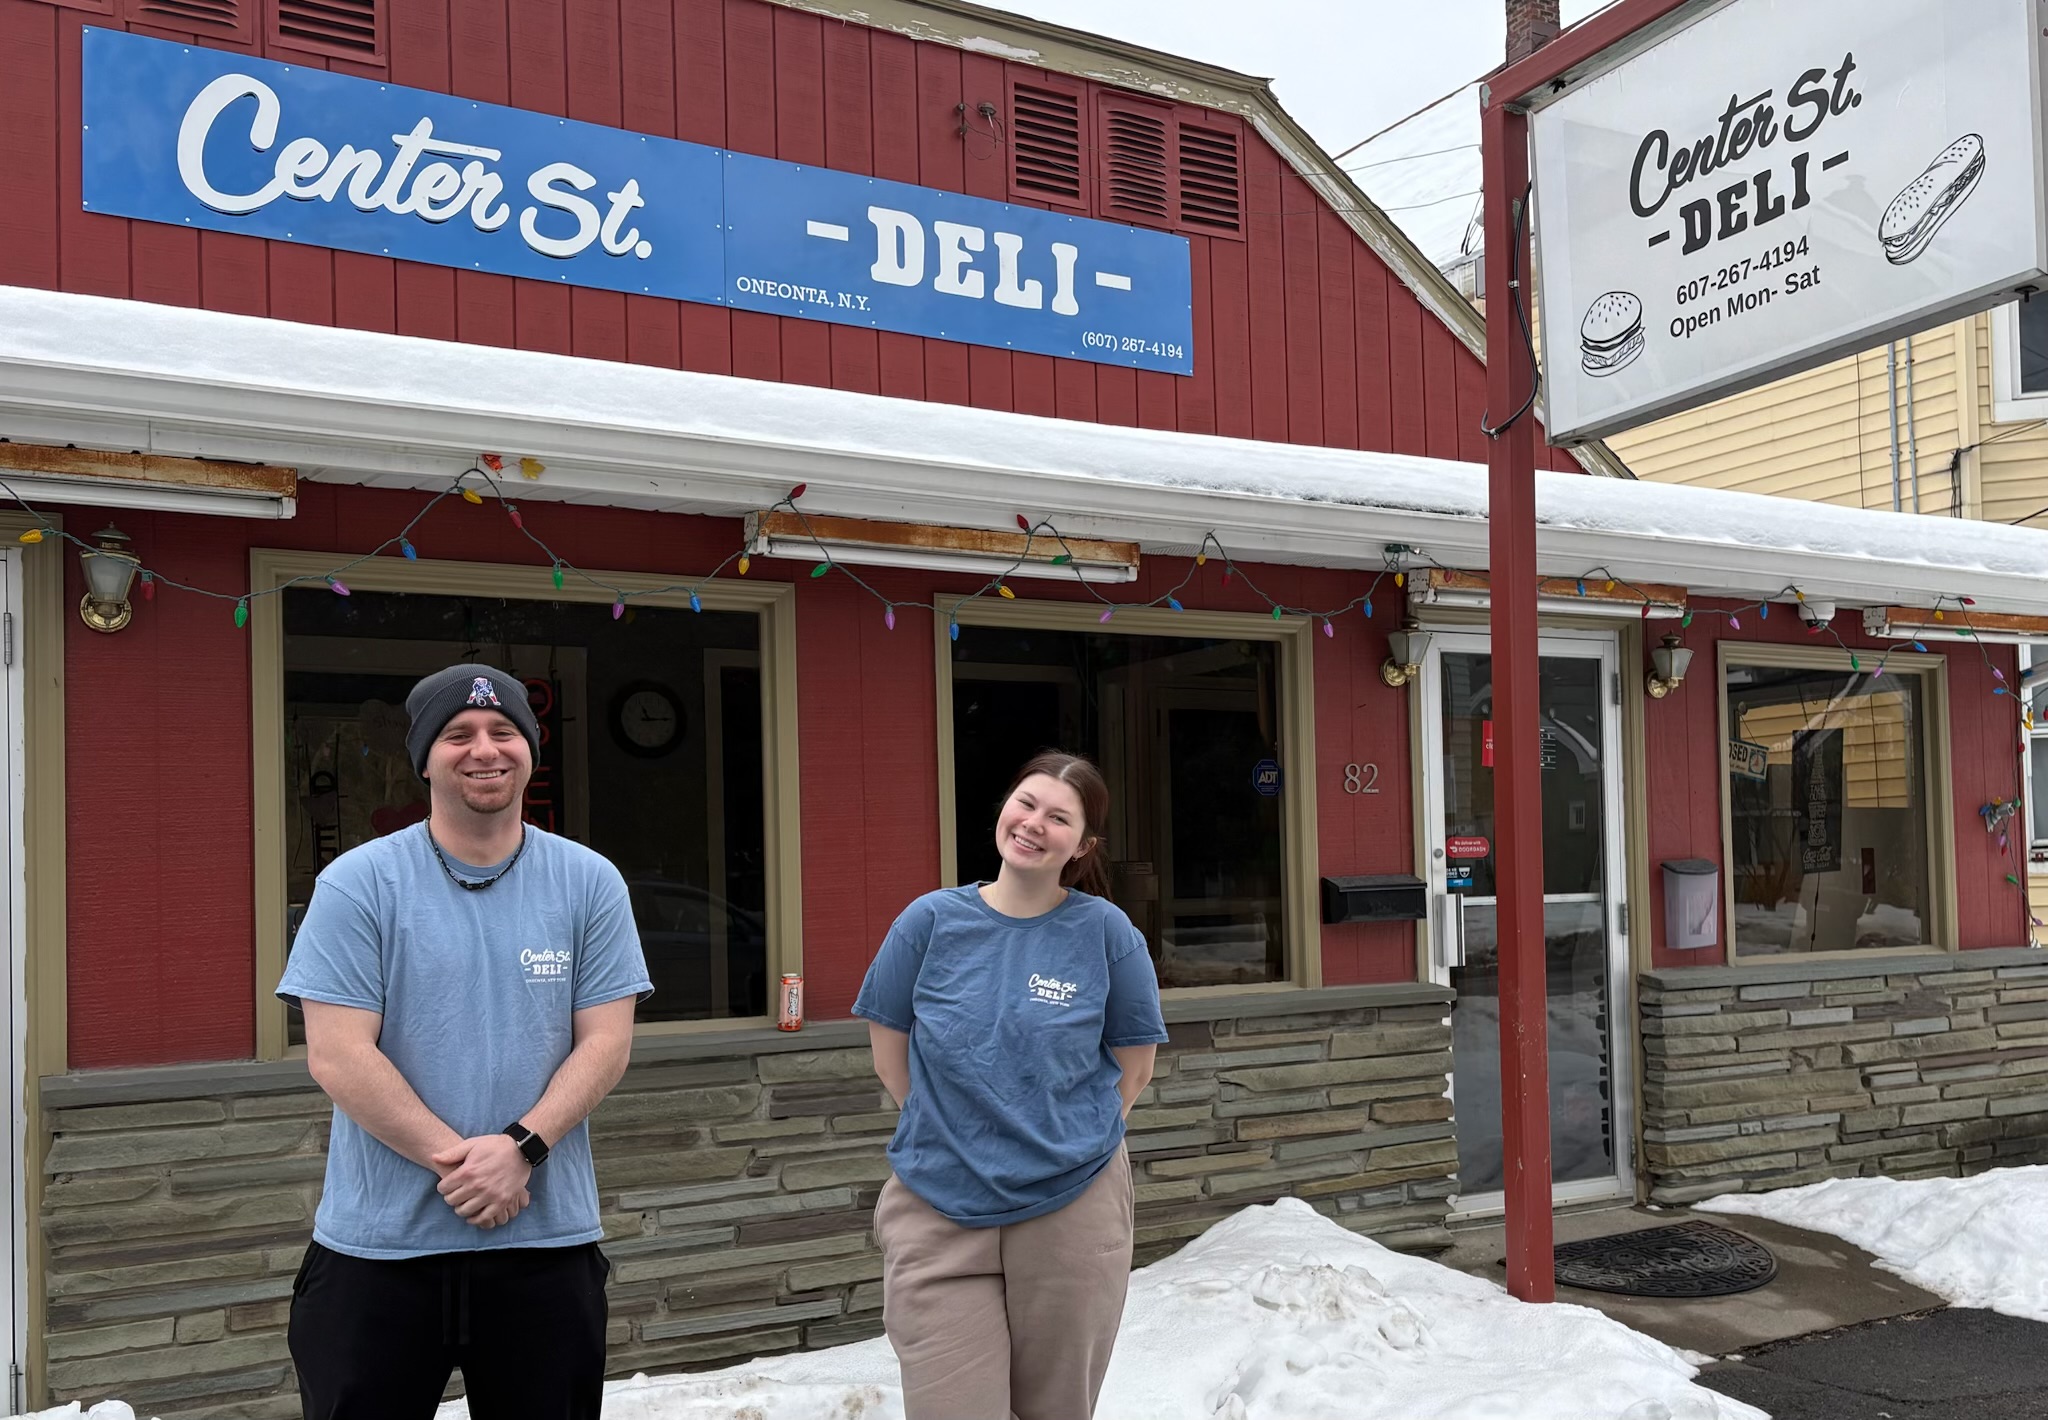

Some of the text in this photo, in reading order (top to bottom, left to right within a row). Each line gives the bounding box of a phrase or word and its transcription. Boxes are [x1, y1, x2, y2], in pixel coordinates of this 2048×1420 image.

[1629, 51, 1862, 218] Center St.
[176, 73, 652, 259] Center St.
[1676, 234, 1810, 305] 607-267-4194
[736, 276, 872, 312] ONEONTA, N.Y.
[1669, 265, 1821, 339] Open Mon- Sat
[1082, 331, 1184, 359] (607) 267-4194
[1258, 770, 1278, 784] ADT
[1344, 763, 1380, 794] 82
[520, 948, 571, 965] Center St.
[1028, 973, 1062, 990] Center
